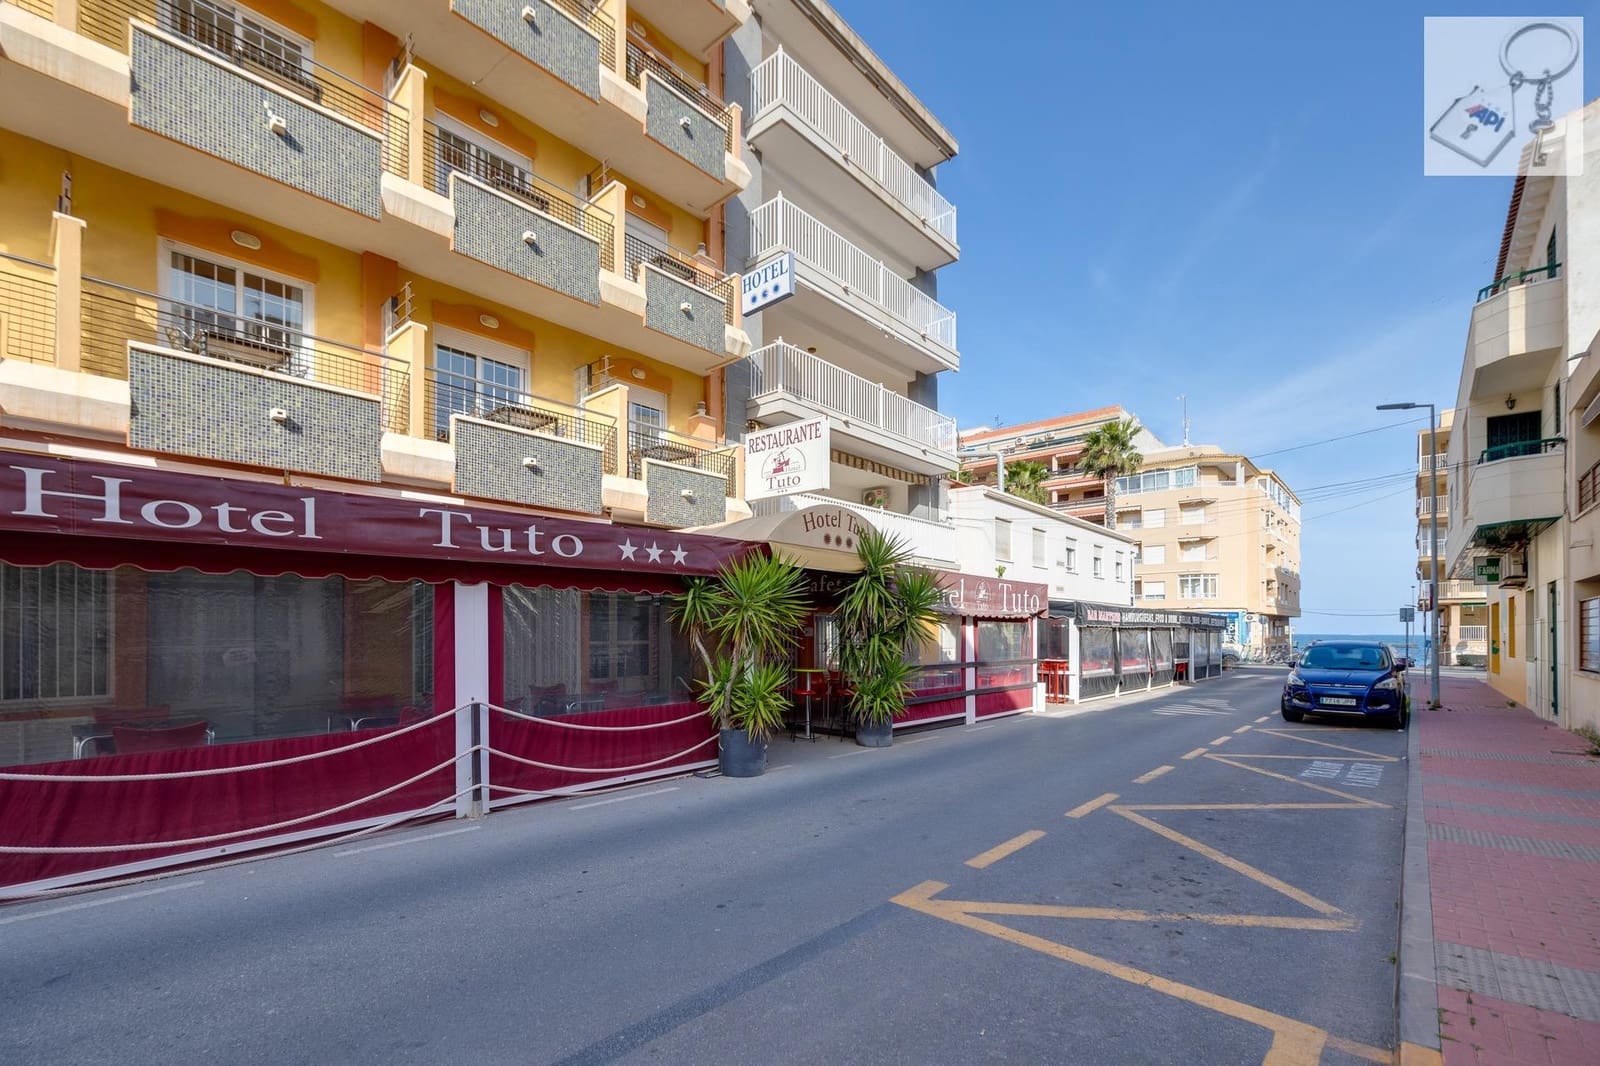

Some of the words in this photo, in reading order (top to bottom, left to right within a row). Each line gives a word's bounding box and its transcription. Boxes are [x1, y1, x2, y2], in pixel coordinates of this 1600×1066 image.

[742, 258, 789, 295] HOTEL
[748, 420, 822, 455] RESTAURANTE
[766, 475, 801, 489] Tuto
[9, 464, 322, 539] Hotel
[419, 507, 584, 559] Tuto
[802, 510, 842, 532] Hotel
[1000, 583, 1039, 613] Tuto
